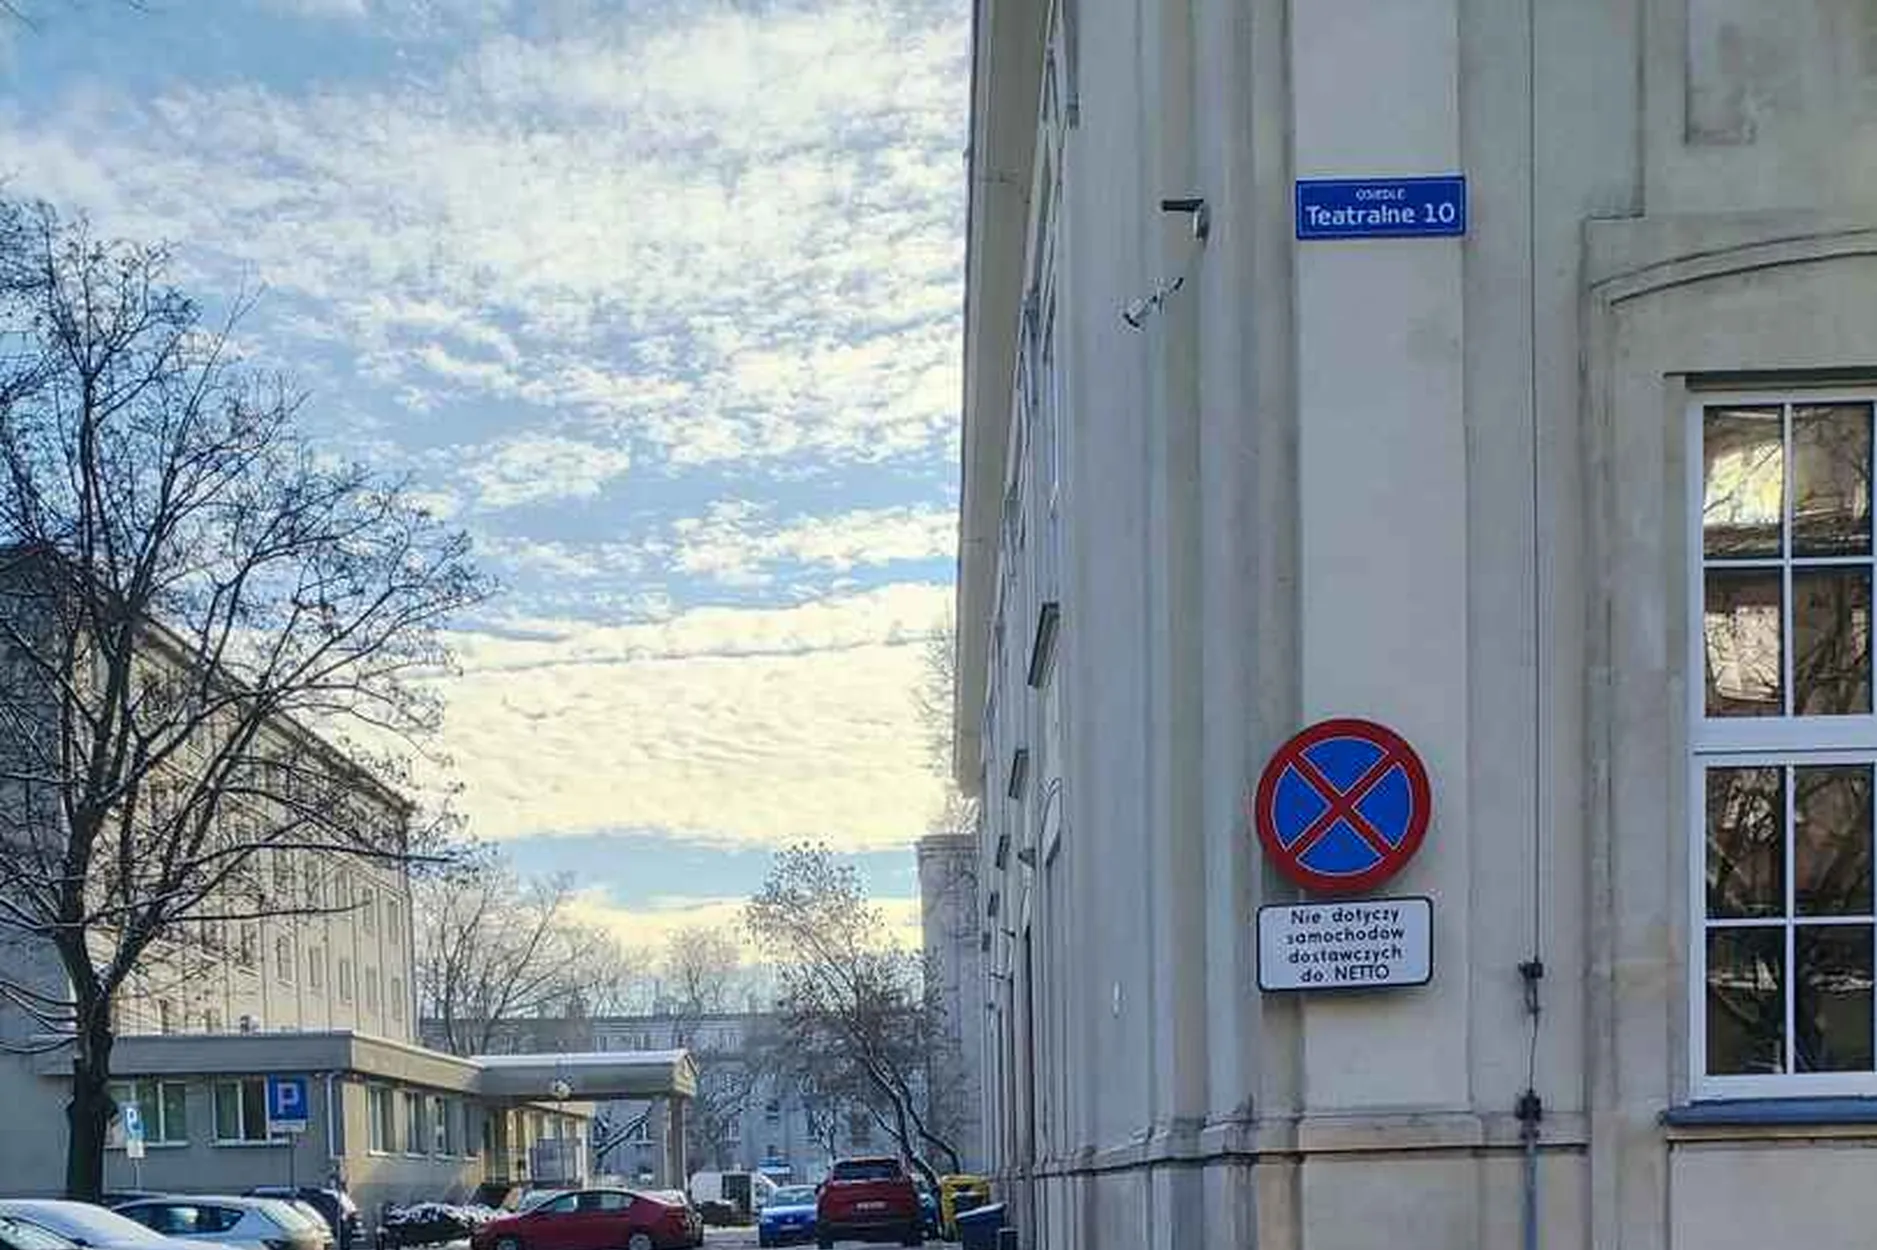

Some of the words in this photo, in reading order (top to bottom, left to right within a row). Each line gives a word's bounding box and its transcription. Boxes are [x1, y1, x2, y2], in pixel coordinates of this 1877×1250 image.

[1305, 205, 1415, 226] Teatralne
[1424, 202, 1455, 223] 10
[1291, 910, 1322, 925] Nie
[1332, 907, 1400, 926] dotyczy
[1288, 944, 1402, 964] dostawczych
[1300, 969, 1325, 983] do
[1334, 964, 1390, 981] NETTO
[277, 1083, 299, 1115] P
